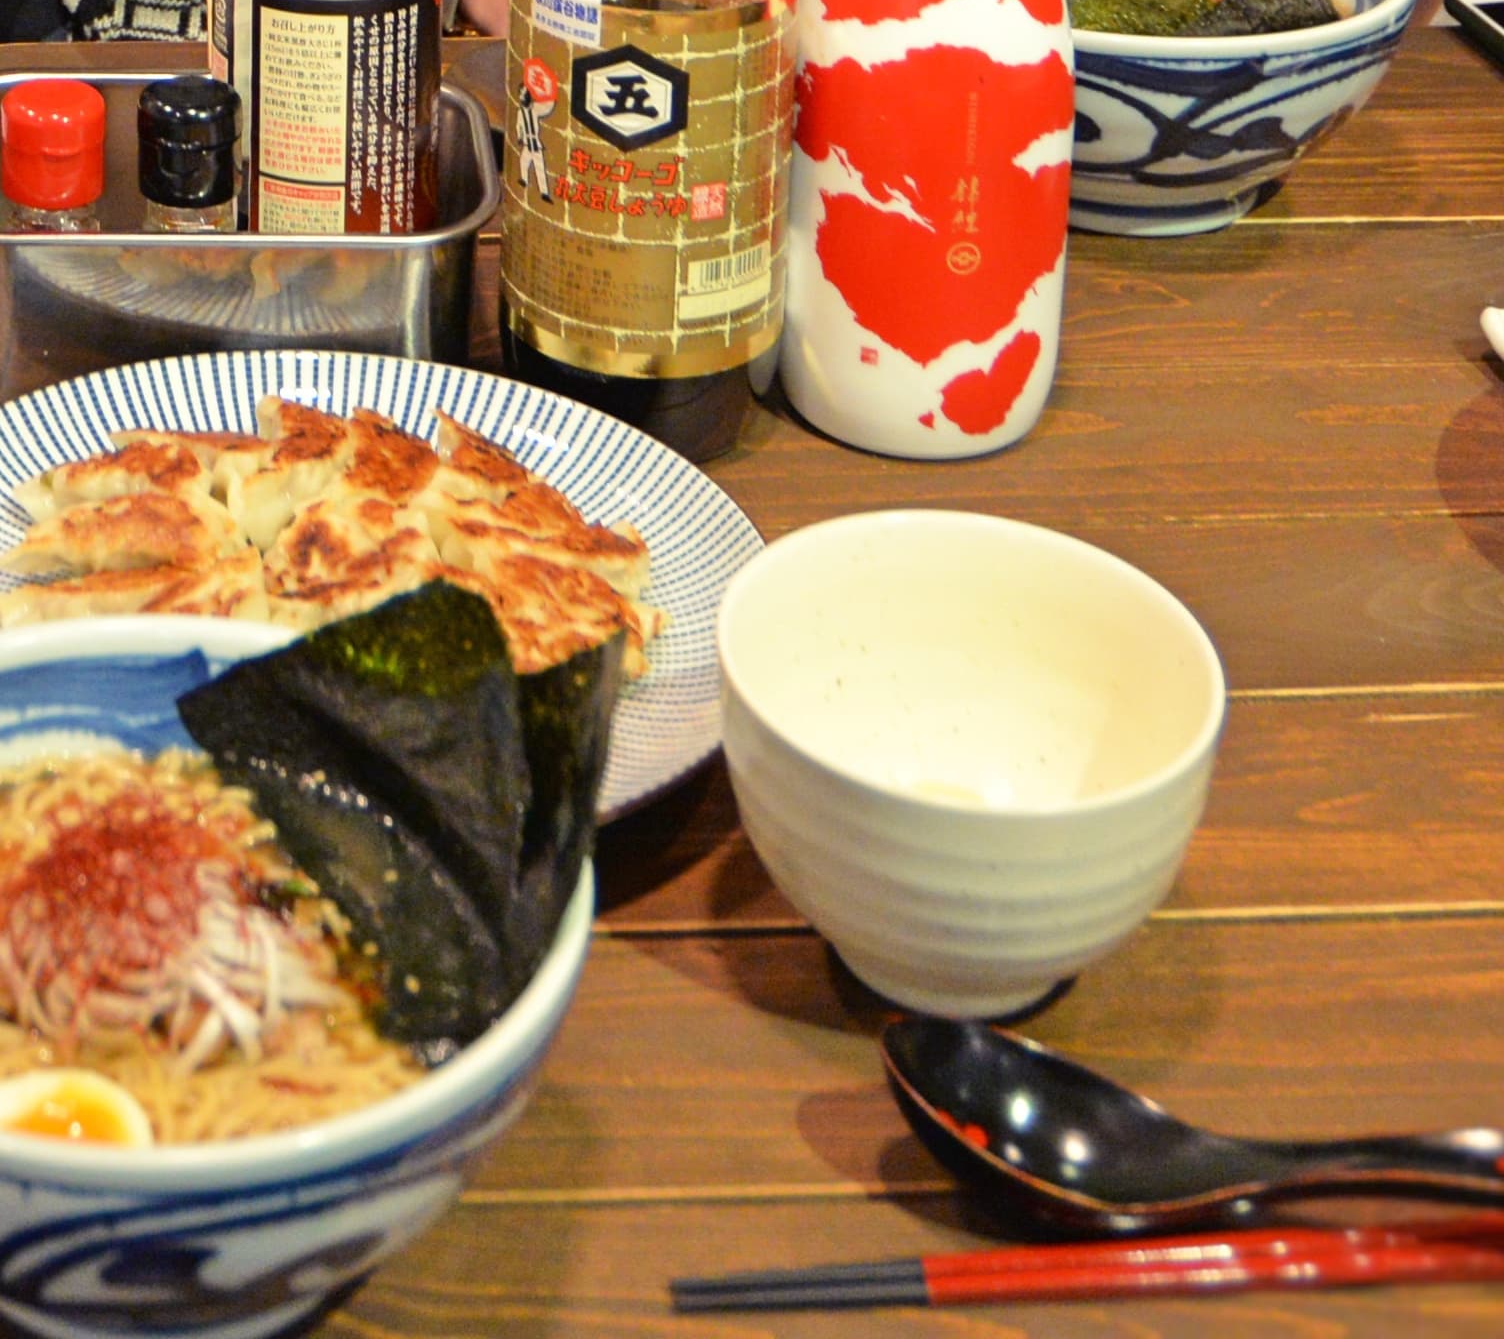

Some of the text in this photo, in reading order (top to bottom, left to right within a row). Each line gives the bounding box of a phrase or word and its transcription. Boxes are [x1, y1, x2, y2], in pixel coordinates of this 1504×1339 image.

[598, 75, 659, 118] 五
[569, 148, 686, 186] キッコーゴ
[554, 175, 688, 219] 丸大豆しょうゆ
